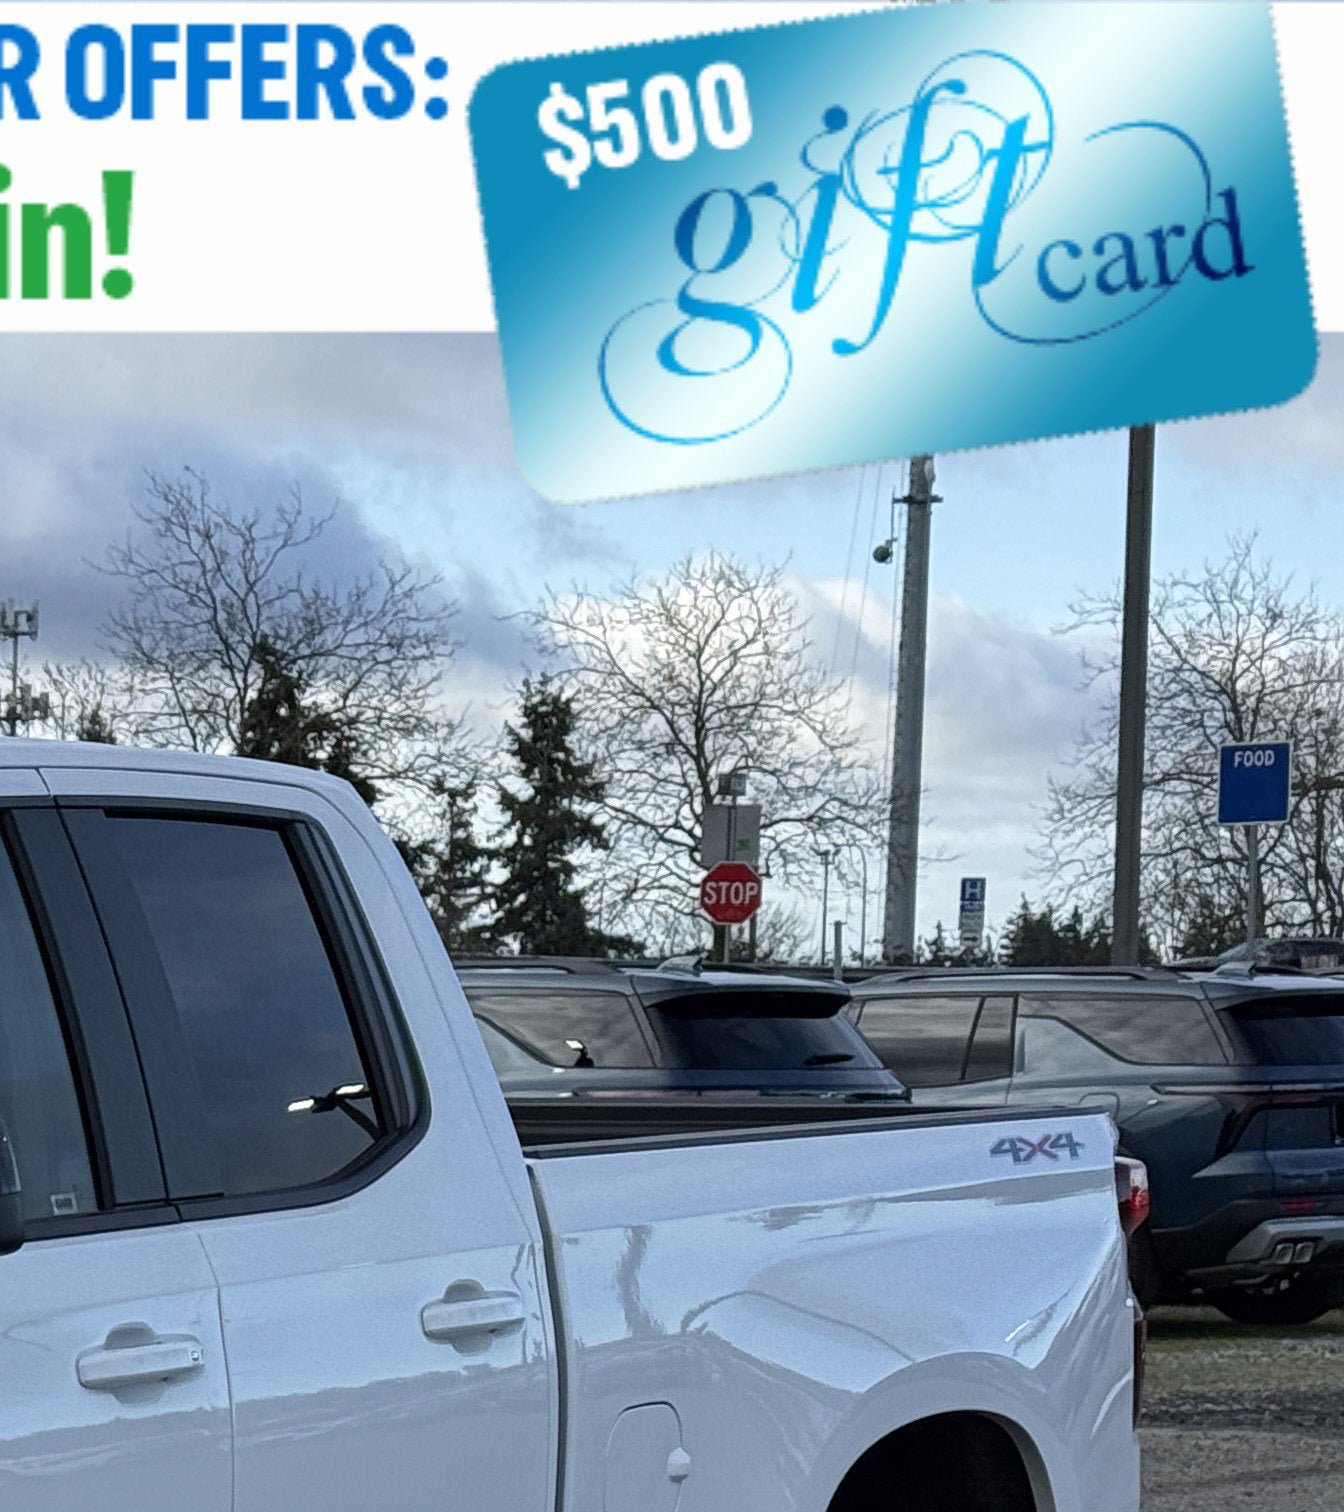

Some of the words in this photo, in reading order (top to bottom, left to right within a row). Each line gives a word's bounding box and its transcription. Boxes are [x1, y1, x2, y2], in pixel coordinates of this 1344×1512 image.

[1233, 749, 1276, 769] FOOD
[703, 881, 759, 905] STOP
[964, 880, 982, 900] H
